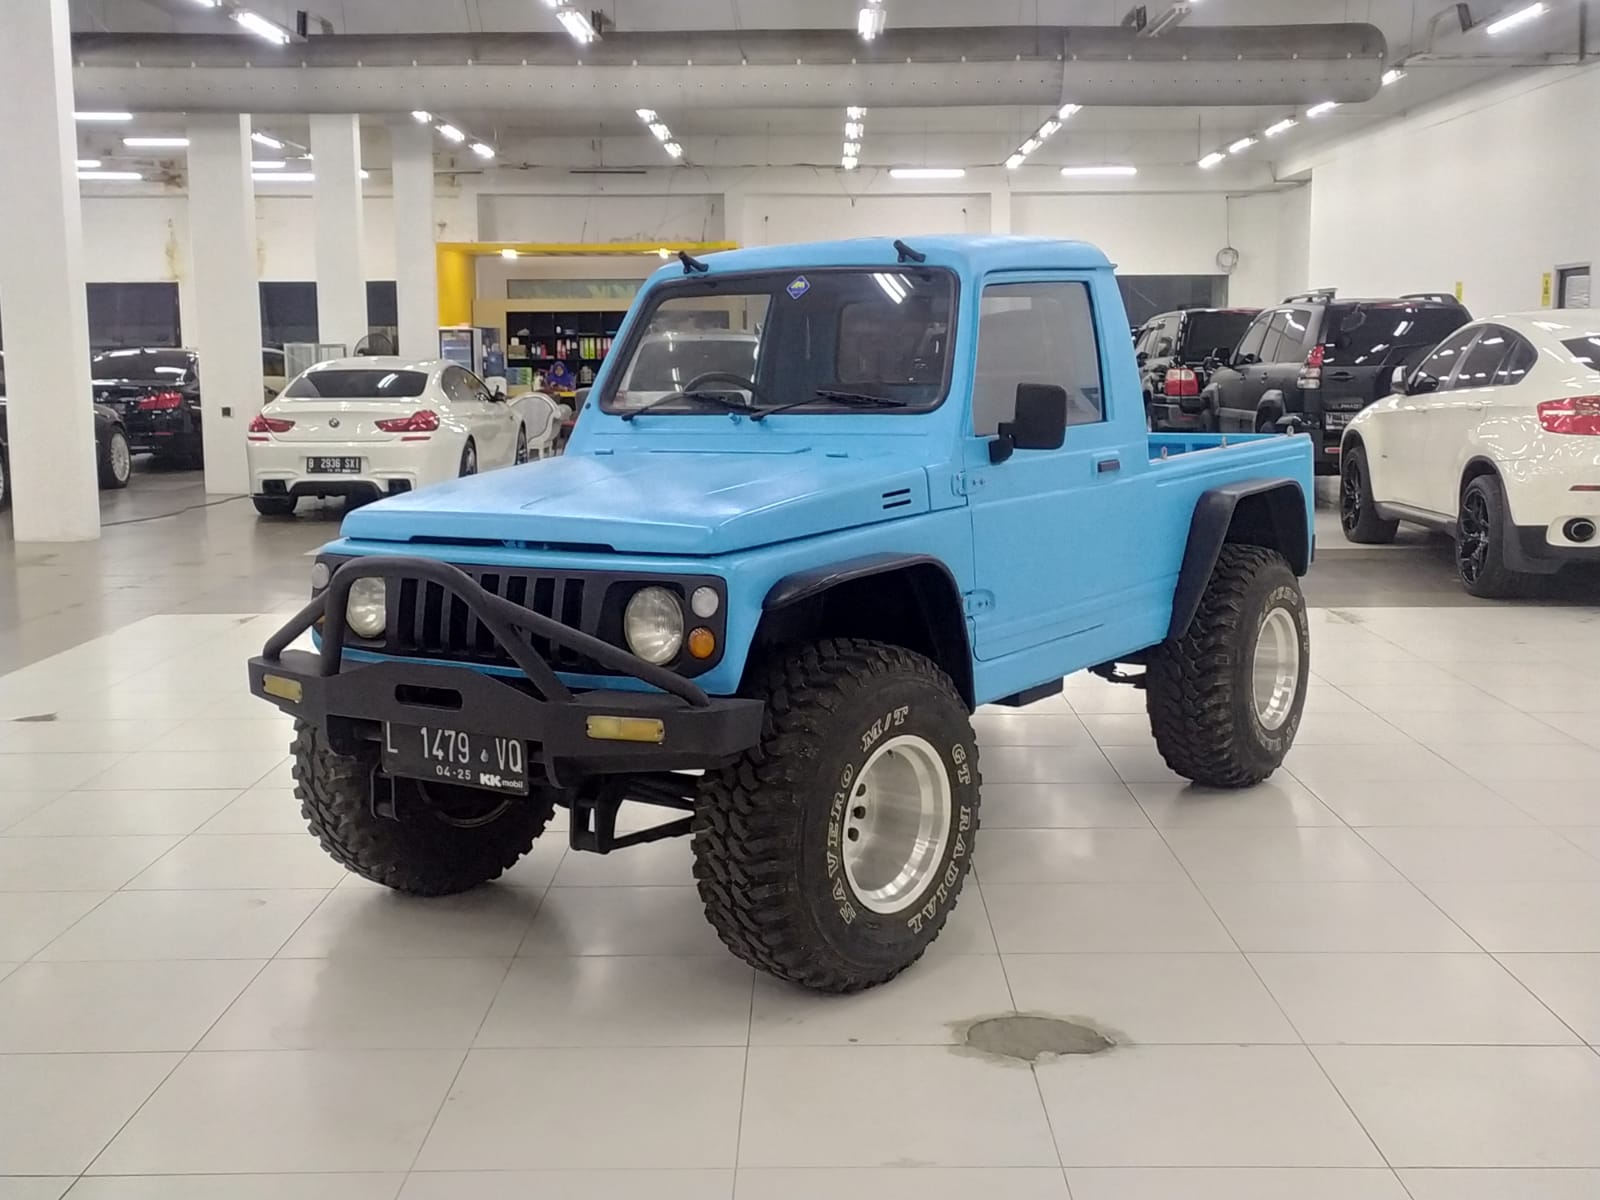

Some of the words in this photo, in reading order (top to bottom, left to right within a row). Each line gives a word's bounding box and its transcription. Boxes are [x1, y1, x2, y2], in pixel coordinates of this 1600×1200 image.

[386, 720, 398, 753] L
[420, 726, 470, 763] 1479
[495, 737, 523, 773] VQ
[860, 705, 909, 752] M/T
[951, 743, 971, 785] GT
[827, 763, 857, 925] SAVERO
[907, 805, 971, 934] RADIAL
